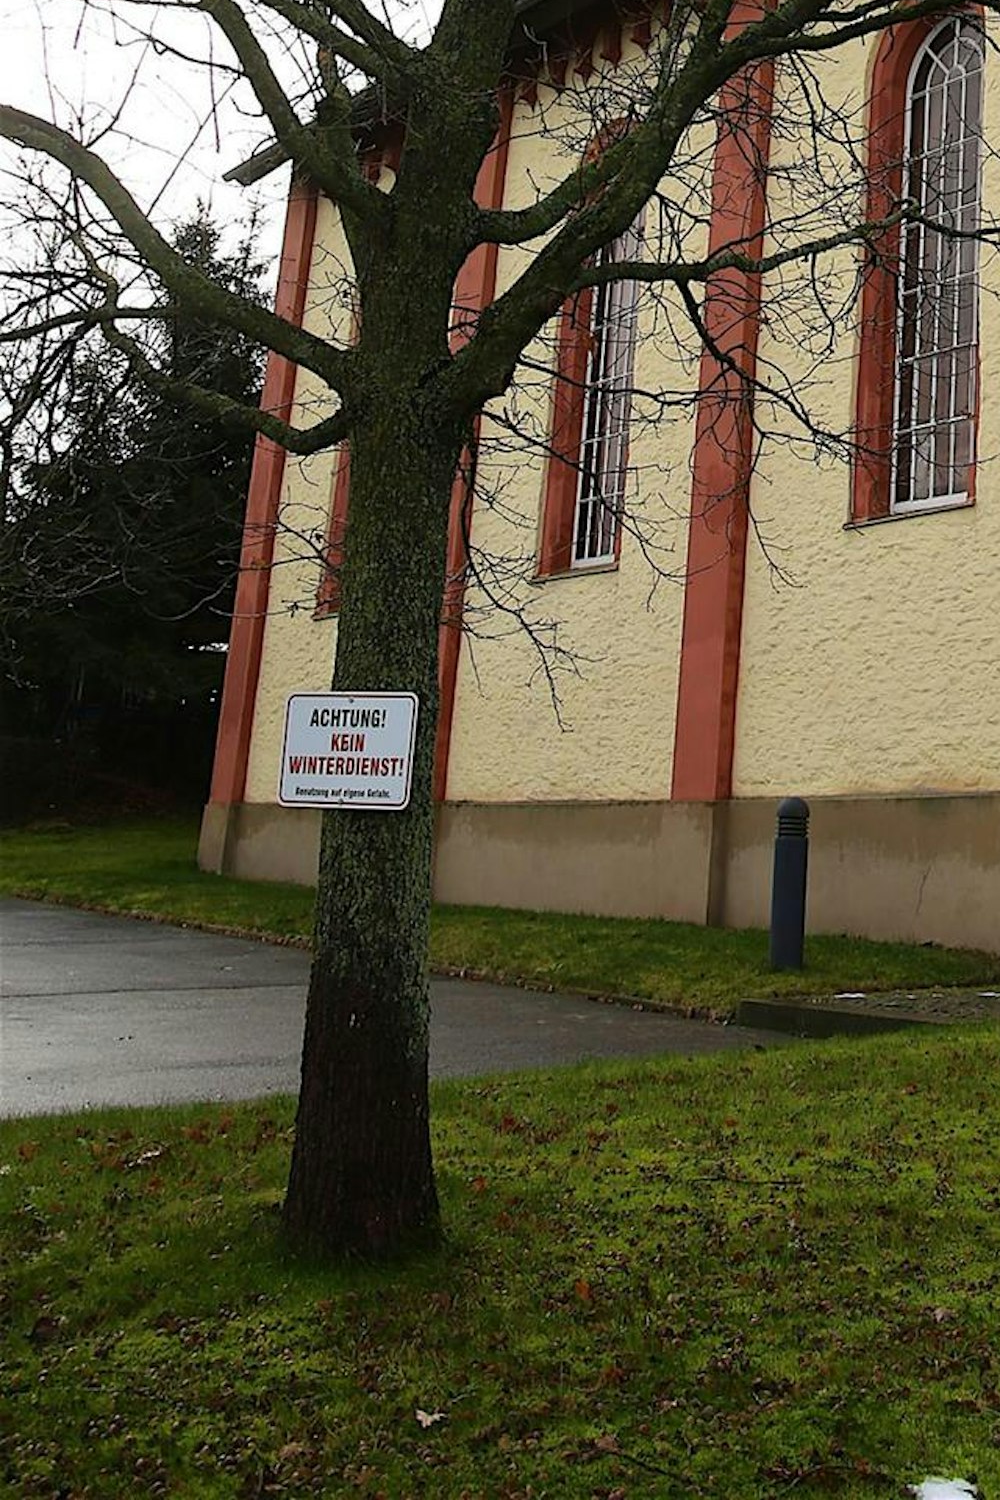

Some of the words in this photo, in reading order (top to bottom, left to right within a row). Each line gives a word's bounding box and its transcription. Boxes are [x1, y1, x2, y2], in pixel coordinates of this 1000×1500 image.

[309, 708, 387, 728] ACHTUNG!
[331, 733, 365, 752] KEIN
[289, 756, 404, 777] WINTERDIENST!
